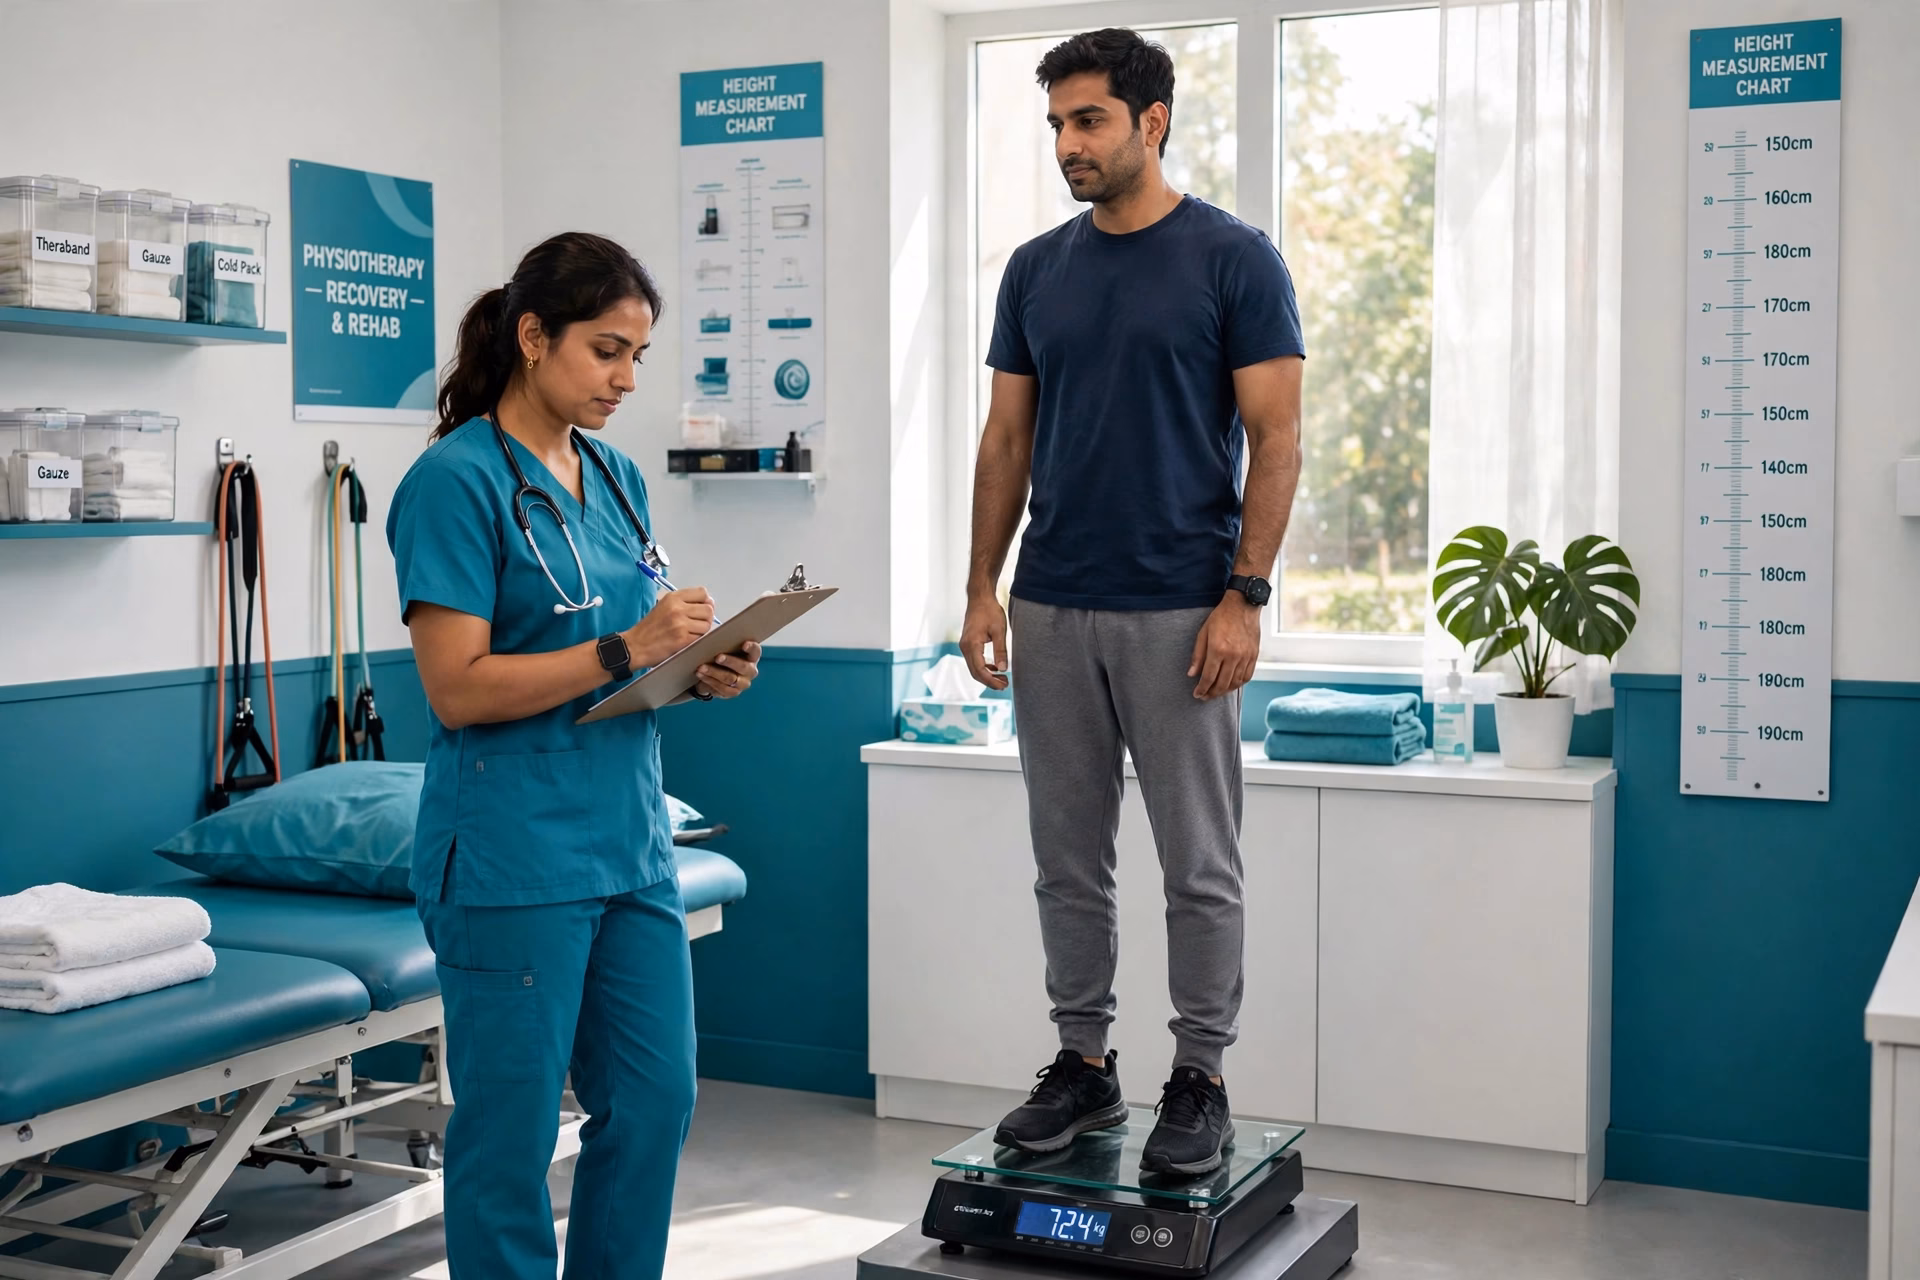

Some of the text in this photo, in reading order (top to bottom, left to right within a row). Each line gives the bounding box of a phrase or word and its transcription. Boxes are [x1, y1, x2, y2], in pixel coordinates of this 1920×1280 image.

[1735, 34, 1794, 52] HEIGHT
[1703, 53, 1827, 76] MEASUREMENT
[724, 76, 776, 93] HEIGHT
[1737, 78, 1791, 96] CHART
[696, 94, 807, 116] MEASUREMENT
[726, 116, 775, 134] CHART
[1766, 136, 1813, 152] 150cm
[1765, 190, 1812, 205] 160cm
[36, 237, 90, 256] Theraband
[1765, 244, 1811, 259] 180cm
[143, 249, 171, 265] Gauze
[304, 244, 425, 281] PHYSIOTHERAPY
[218, 258, 262, 276] Cold Pack
[326, 280, 408, 311] RECOVERY
[1764, 298, 1811, 313] 170cm
[332, 312, 401, 338] & REHAB
[1764, 352, 1810, 367] 170cm
[1763, 406, 1809, 421] 150cm
[38, 466, 69, 480] Gauze
[1762, 460, 1808, 475] 140cm
[1761, 514, 1807, 529] 150cm
[1761, 567, 1806, 582] 180cm
[1760, 620, 1805, 635] 180cm
[1758, 726, 1804, 742] 190cm
[1051, 1209, 1106, 1240] 72.4 kg
